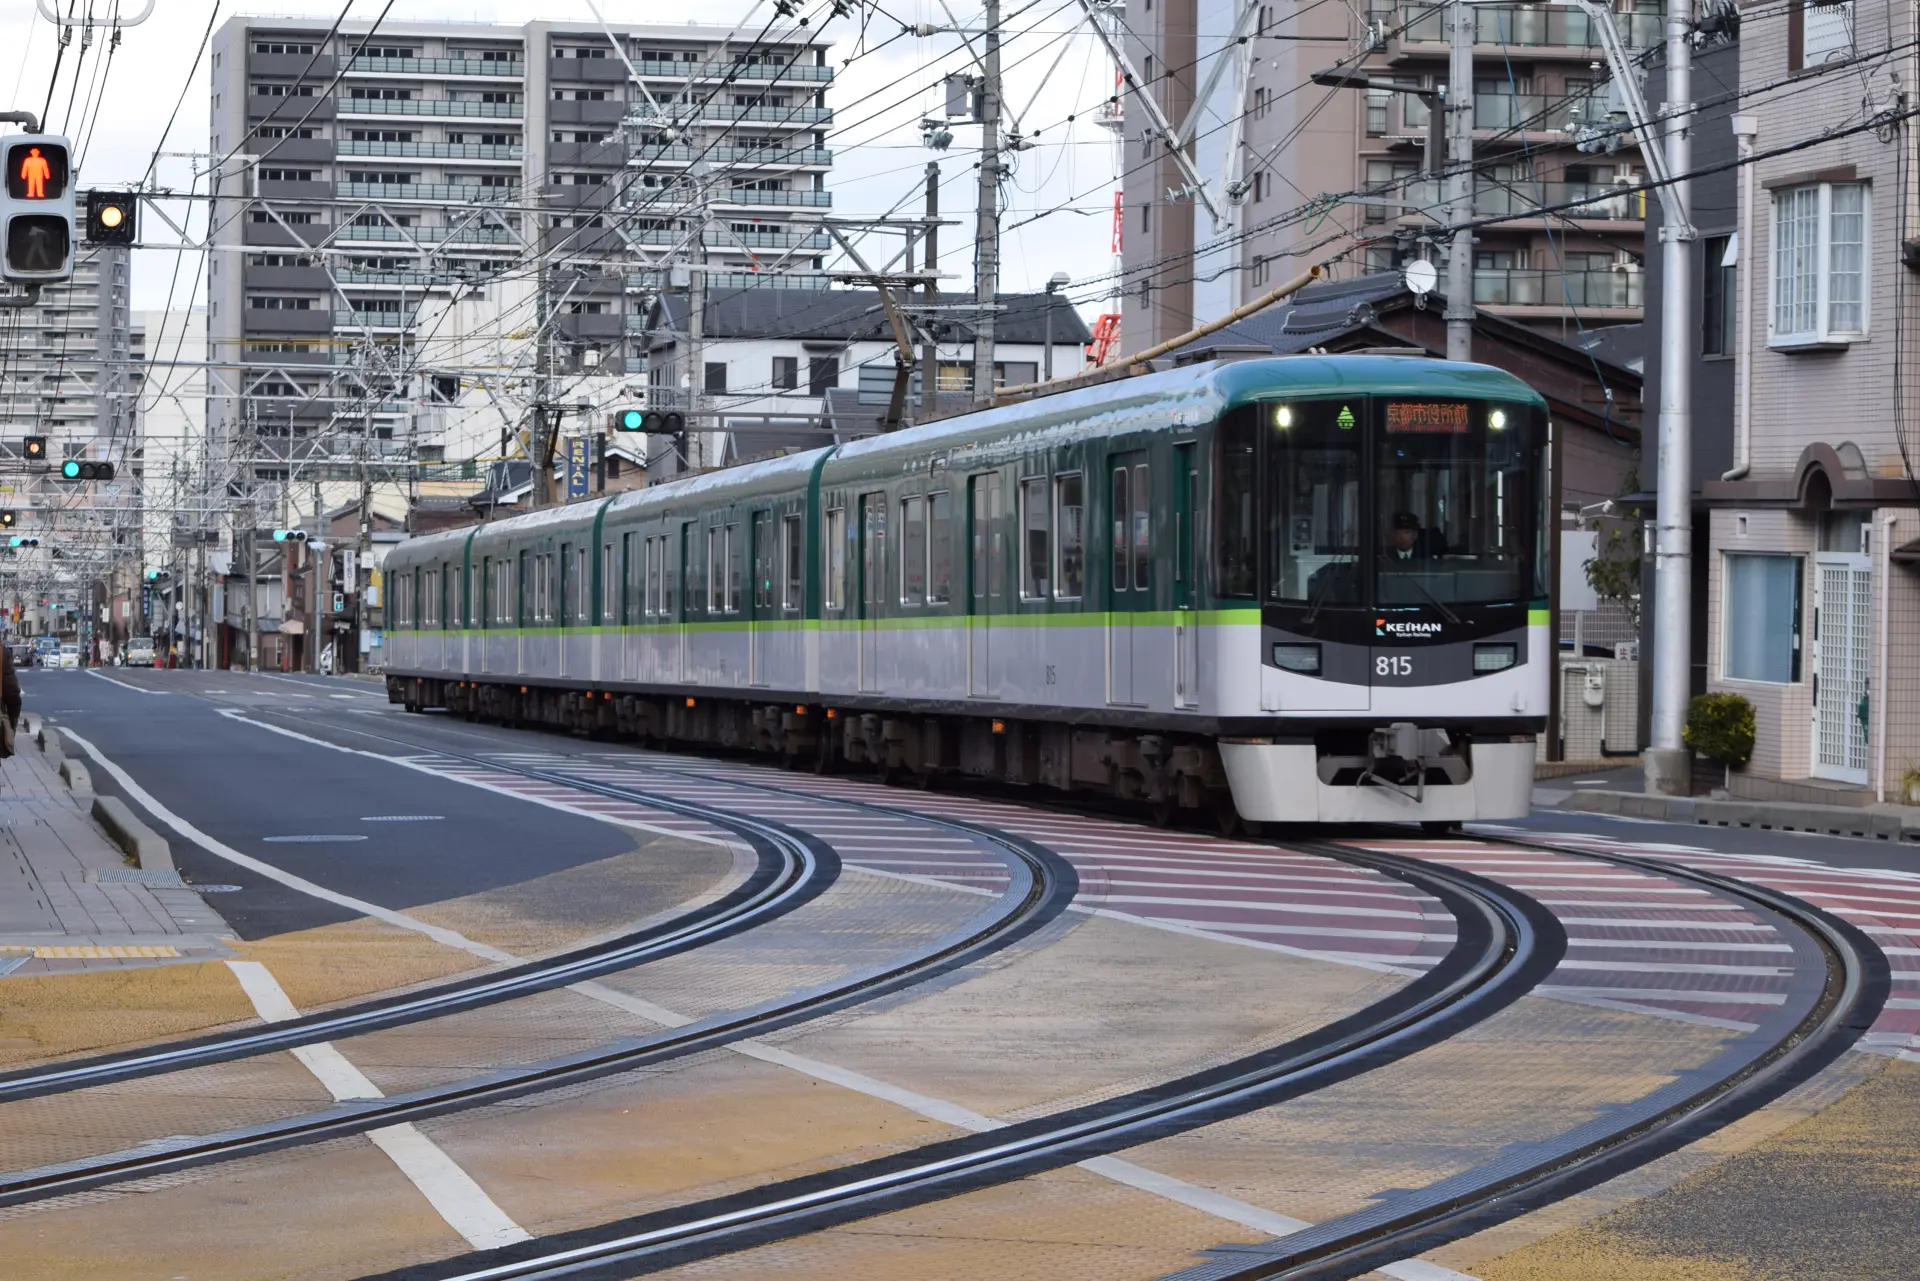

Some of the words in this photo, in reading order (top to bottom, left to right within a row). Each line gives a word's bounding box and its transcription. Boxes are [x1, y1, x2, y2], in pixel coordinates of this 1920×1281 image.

[1387, 403, 1469, 424] 京都市役所前
[1386, 622, 1442, 632] KEIHAN
[1376, 656, 1412, 676] 815
